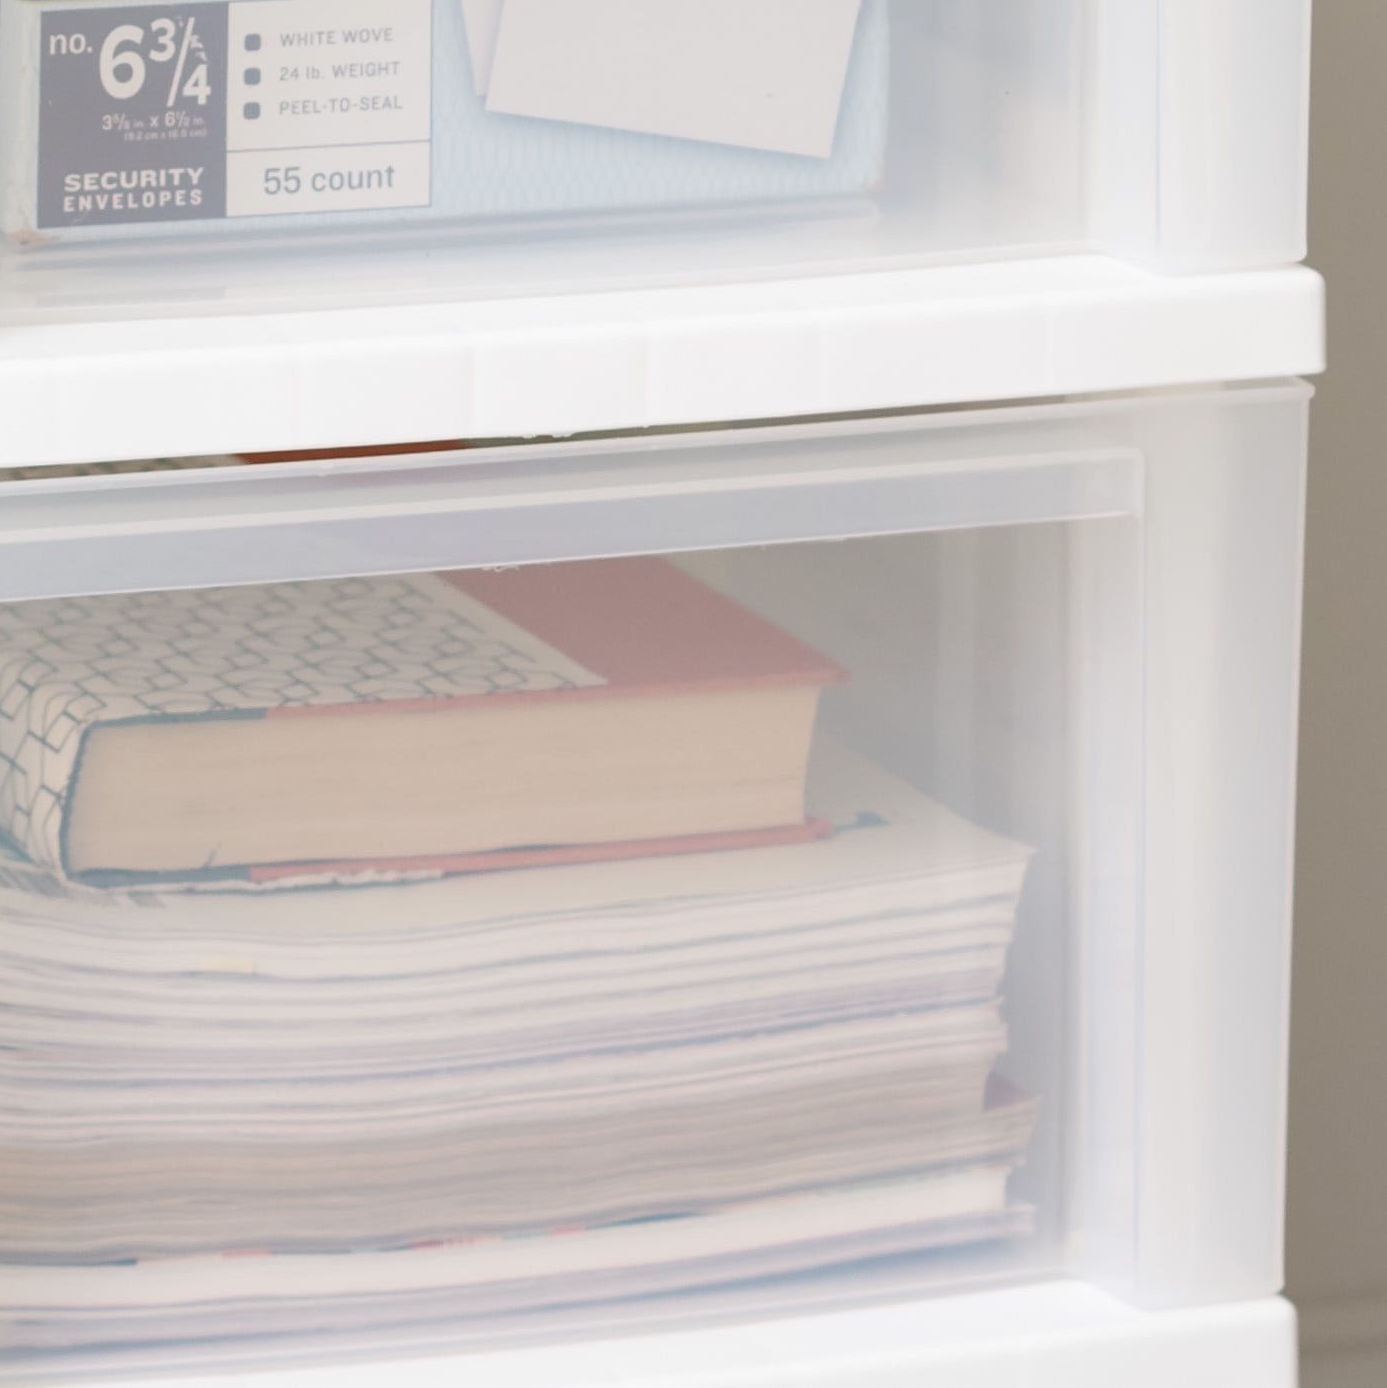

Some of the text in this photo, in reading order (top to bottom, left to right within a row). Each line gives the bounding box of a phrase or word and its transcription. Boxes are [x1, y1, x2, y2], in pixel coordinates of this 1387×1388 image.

[48, 32, 94, 55] no.
[279, 27, 394, 47] WHITE WOVE
[279, 65, 300, 81] 24
[332, 61, 401, 79] WEIGHT
[279, 95, 404, 116] PEEL-TO-SEAL
[63, 166, 205, 193] SECURITY
[263, 164, 395, 196] 55 count
[63, 188, 203, 213] ENVELOPES
